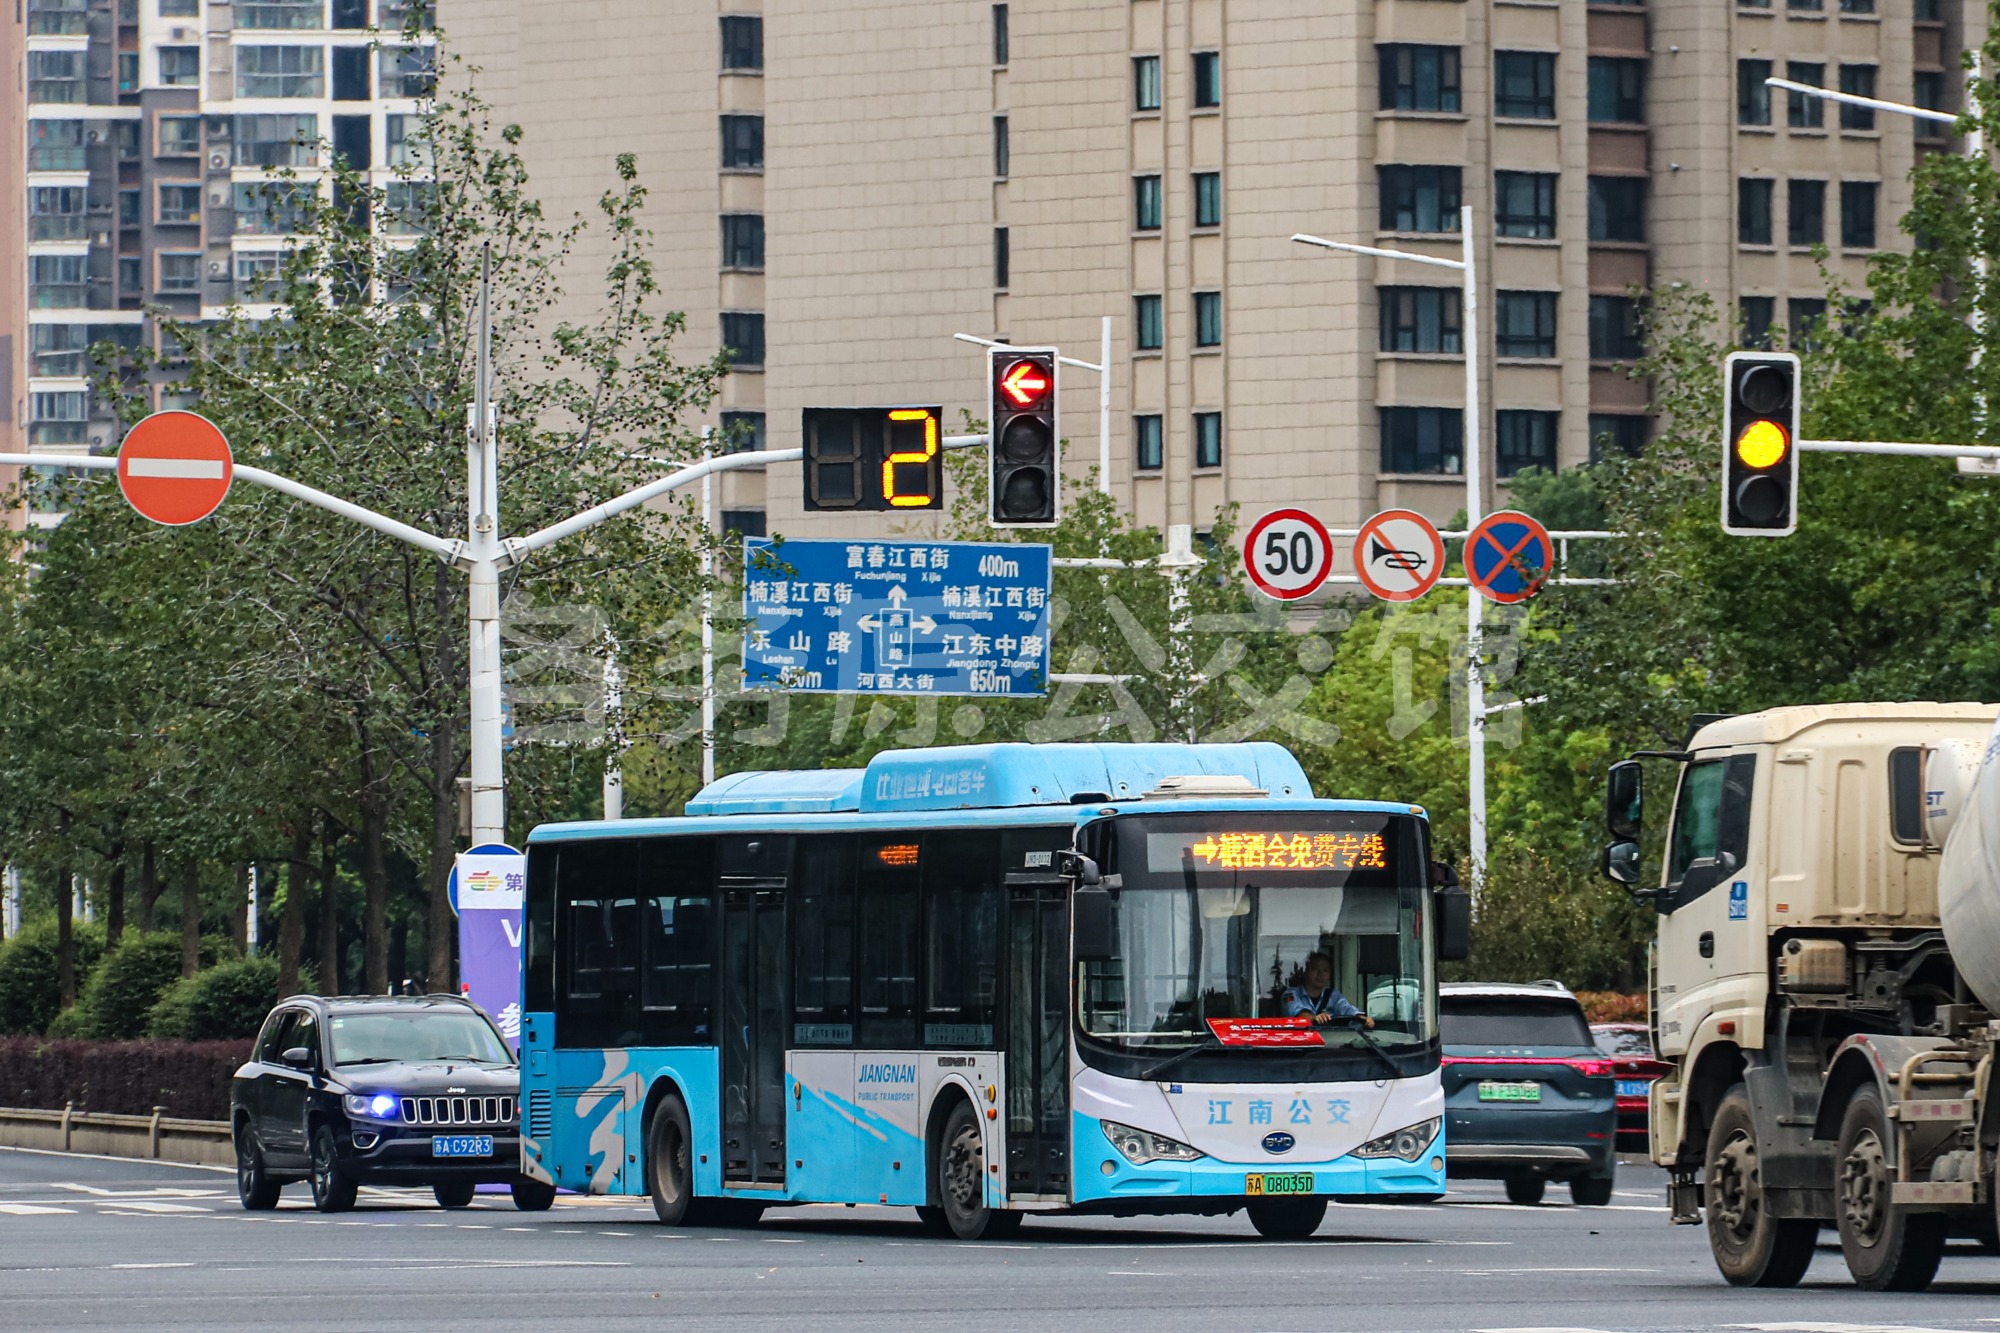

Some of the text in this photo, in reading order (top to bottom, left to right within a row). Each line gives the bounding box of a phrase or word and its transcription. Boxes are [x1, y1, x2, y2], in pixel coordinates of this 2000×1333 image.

[882, 410, 937, 507] 2
[846, 545, 950, 570] 富春江西街
[1265, 530, 1313, 576] 50
[855, 571, 942, 584] Fuchunjiang Xijie
[978, 555, 1019, 578] 400m
[749, 580, 854, 605] 楠溪江西街
[942, 585, 1046, 609] 楠溪江西街
[758, 605, 843, 618] Nanxijiang Xijie
[949, 609, 1037, 622] Nanxijiang Xijie
[749, 629, 853, 654] 乐山路
[889, 613, 905, 662] 燕山路
[942, 633, 1045, 658] 江东中路
[762, 654, 838, 665] Leshan Lu
[946, 658, 1041, 671] Jiangdong Zhonglu
[857, 673, 935, 691] 河西大街
[969, 669, 1011, 693] 650m
[858, 1064, 916, 1083] JIANGNAN
[447, 1086, 466, 1094] Jeep
[857, 1092, 914, 1101] PUBLIC TRANSPORT
[1208, 1100, 1351, 1125] 江南公交
[1265, 1136, 1292, 1148] BYD
